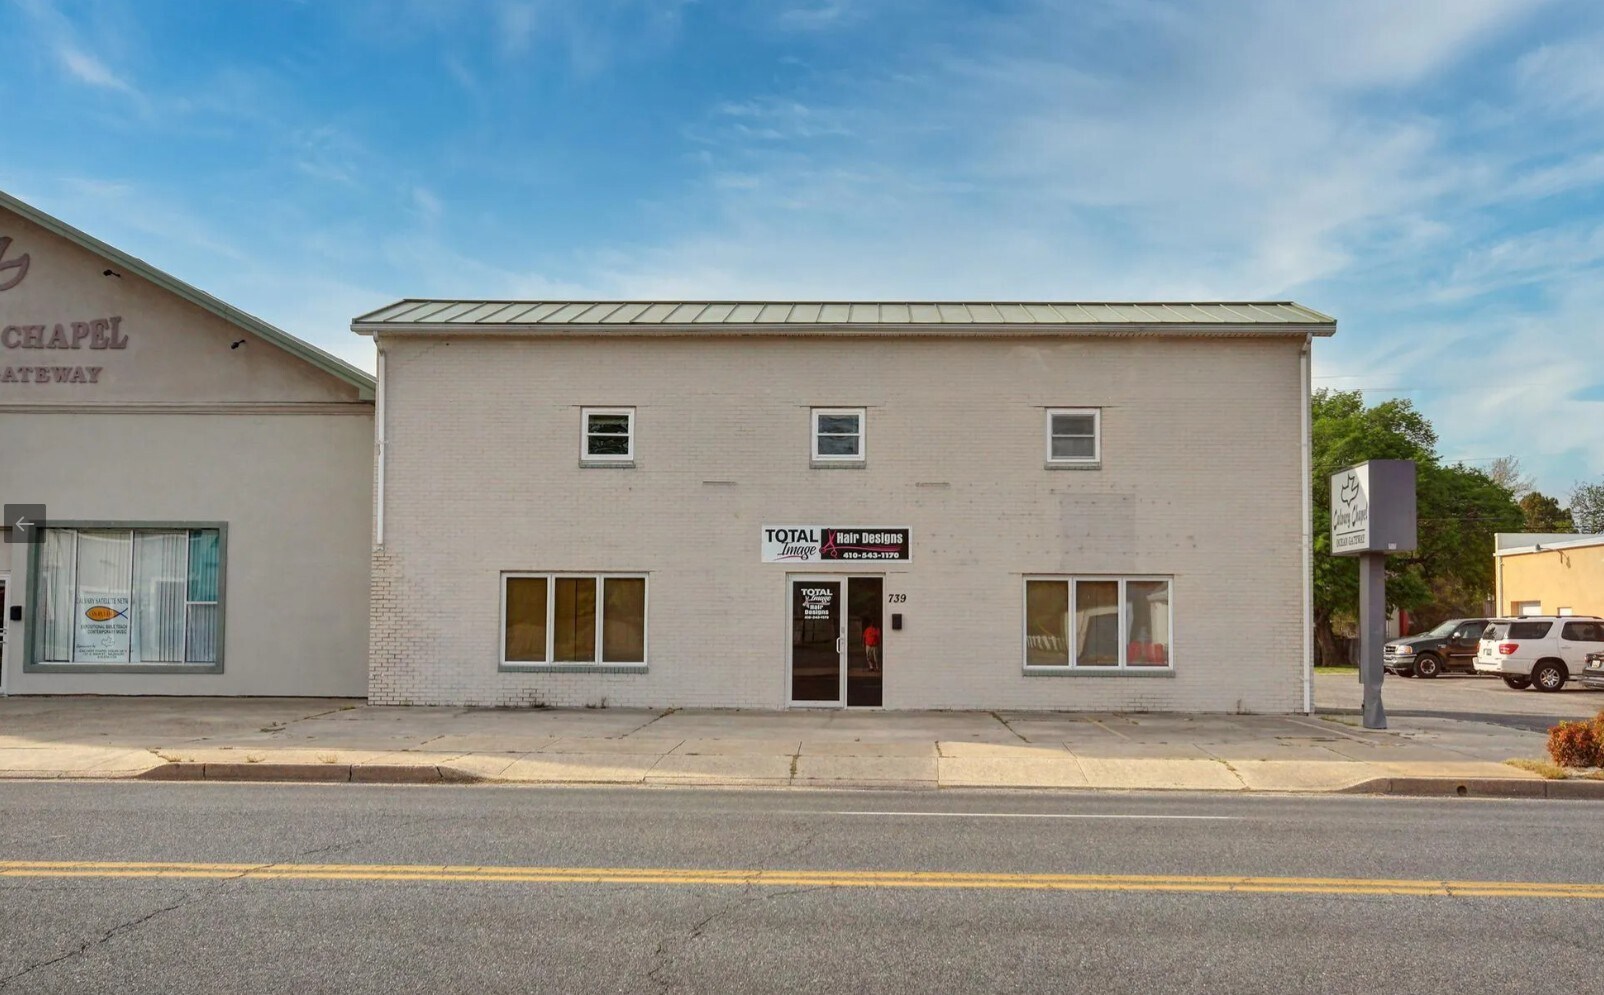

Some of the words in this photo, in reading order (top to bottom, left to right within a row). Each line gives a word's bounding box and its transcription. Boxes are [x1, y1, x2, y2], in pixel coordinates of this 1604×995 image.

[1, 315, 129, 350] CHAPEL
[0, 366, 104, 384] ATEWAY
[1352, 501, 1368, 527] Chapel
[765, 529, 818, 543] TOTAL
[836, 532, 860, 544] Hair
[862, 532, 904, 545] Designs
[777, 542, 817, 560] Image
[843, 551, 900, 559] 410-543-1170
[801, 588, 833, 596] TOTAL
[888, 593, 907, 603] 739
